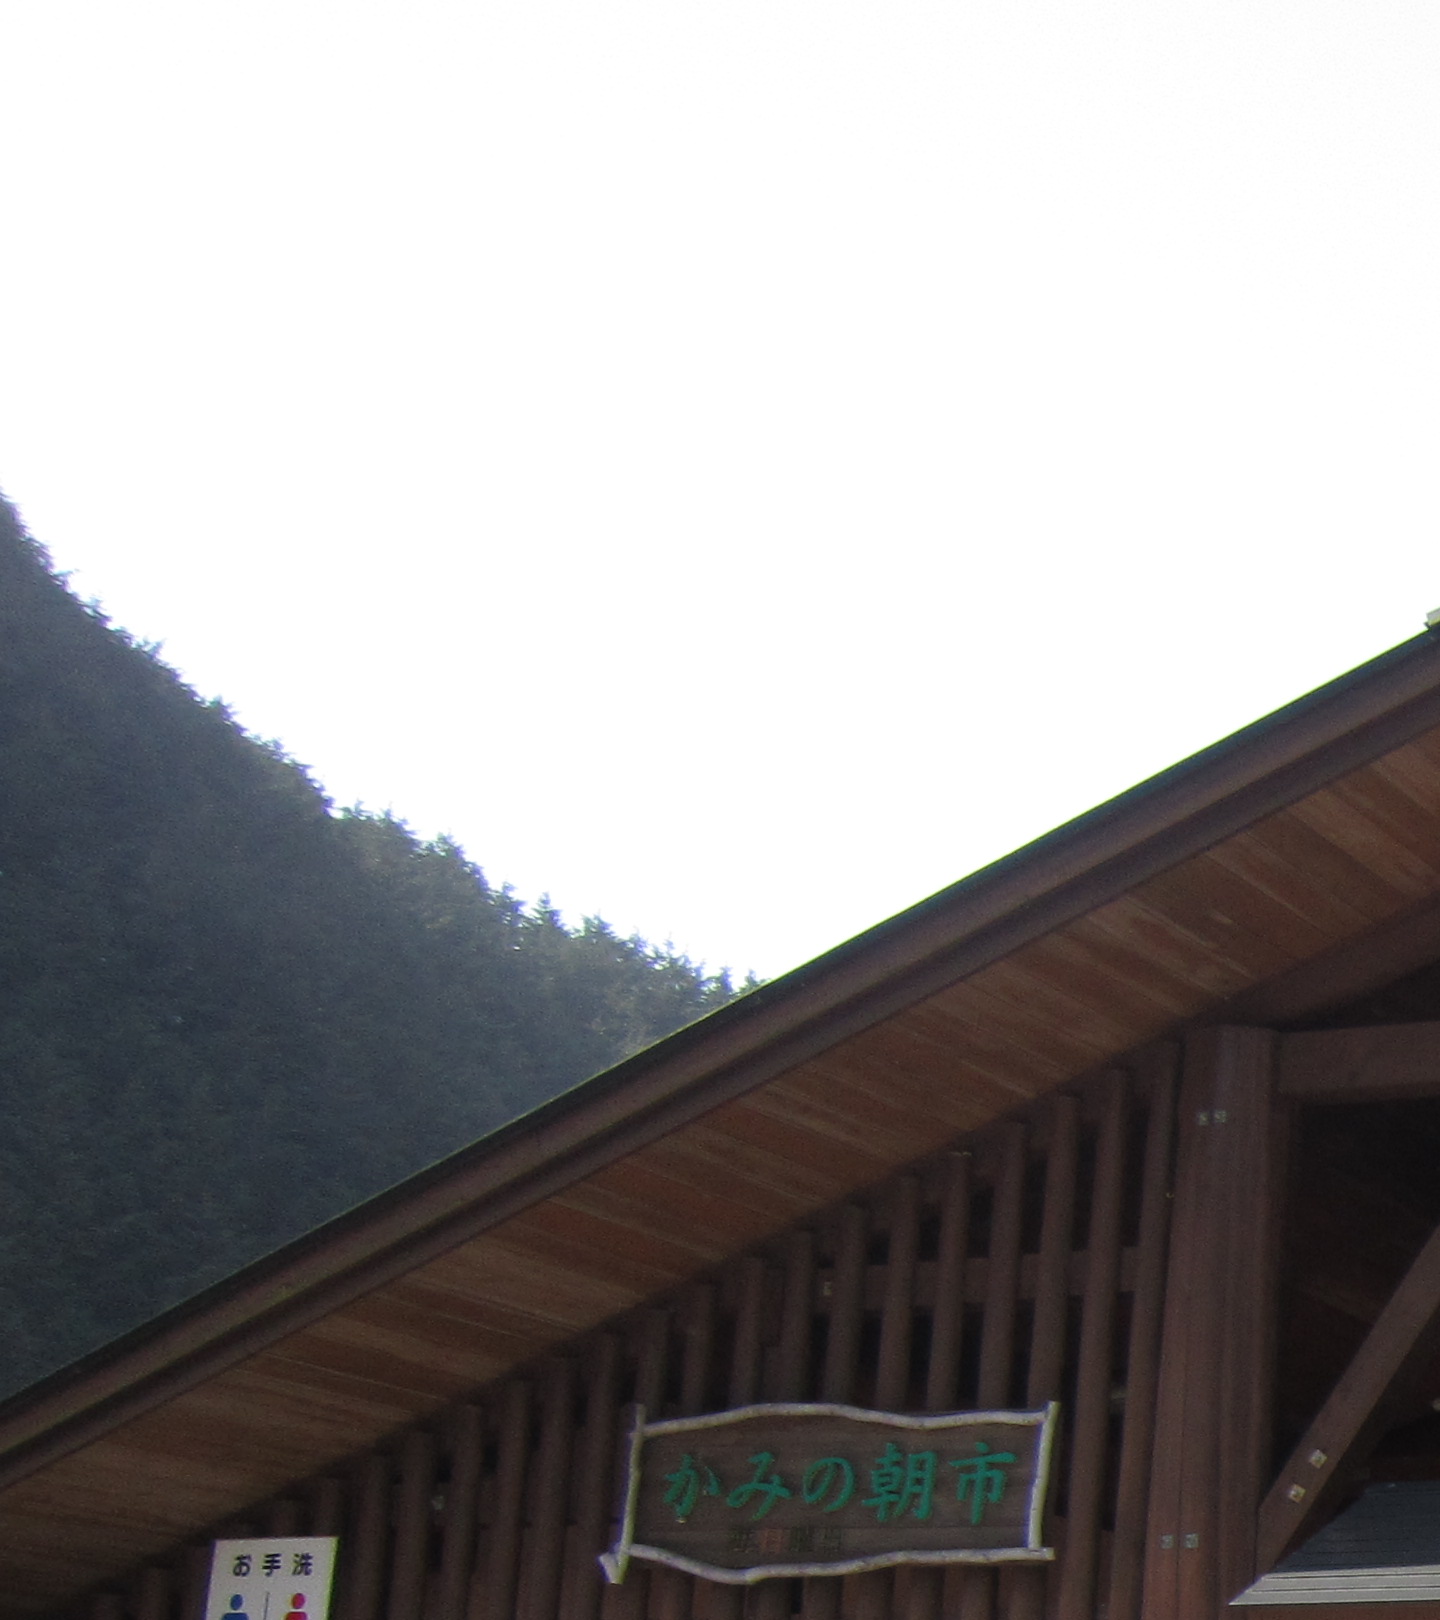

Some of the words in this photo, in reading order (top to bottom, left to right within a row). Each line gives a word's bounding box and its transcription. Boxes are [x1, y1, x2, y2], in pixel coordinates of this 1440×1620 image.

[663, 1441, 1019, 1525] かみの朝市
[231, 1552, 314, 1578] お手洗
